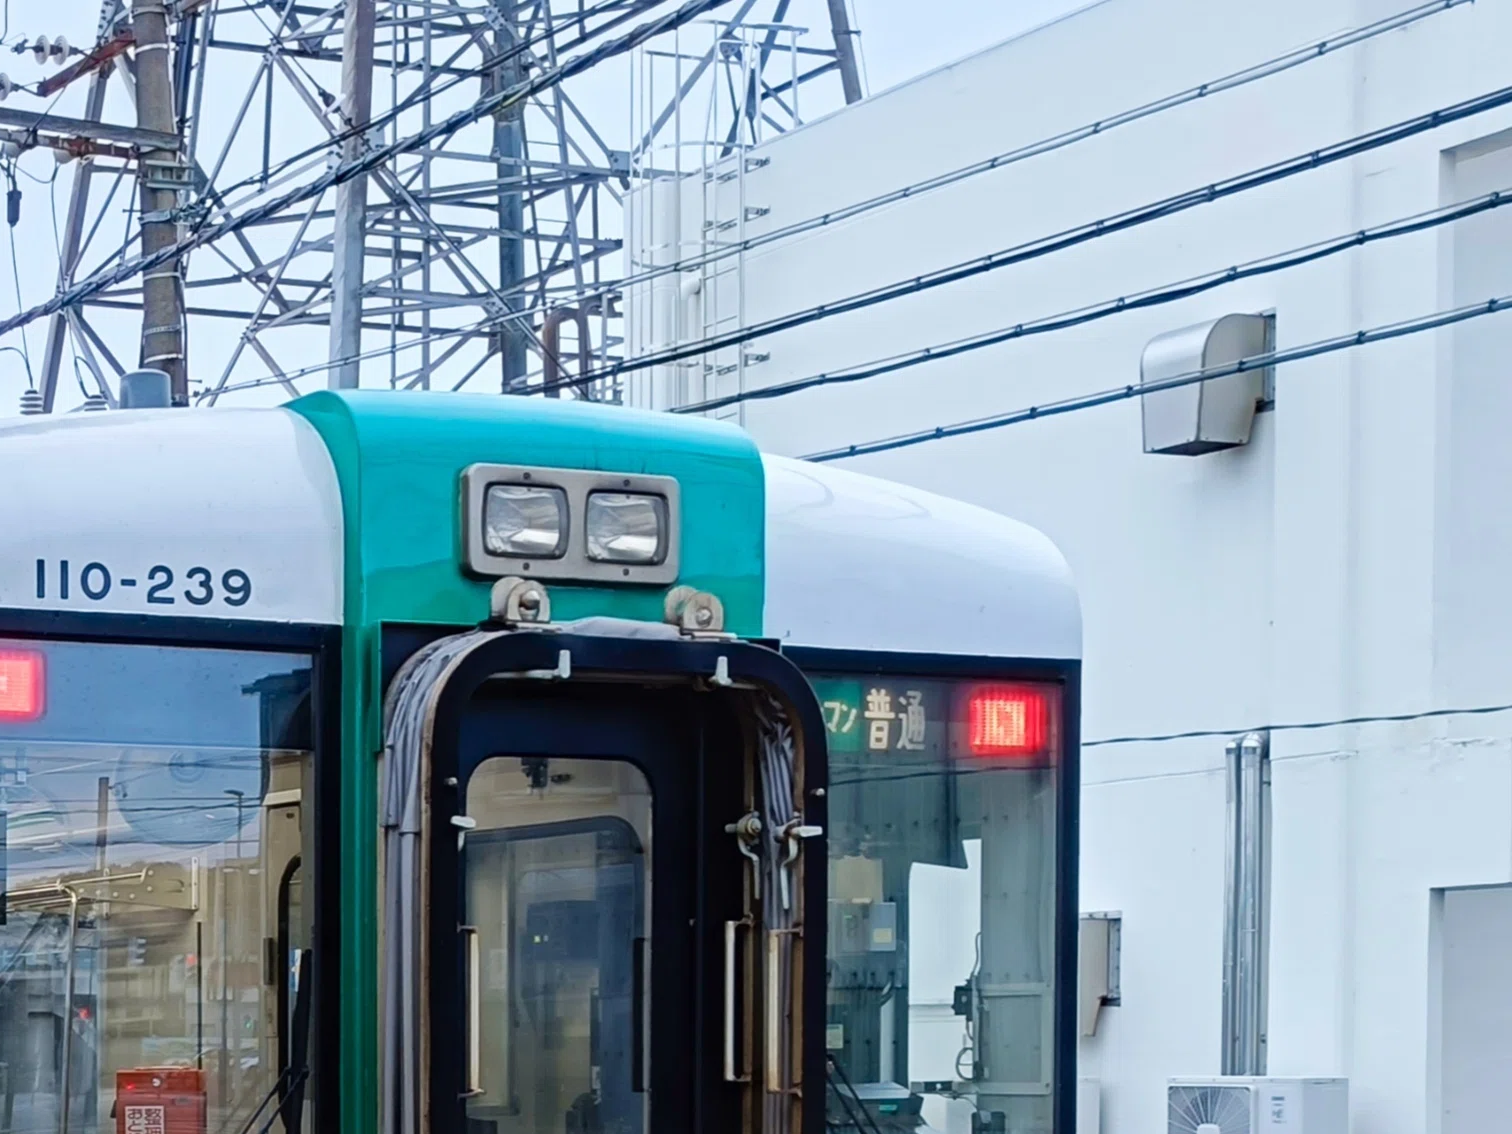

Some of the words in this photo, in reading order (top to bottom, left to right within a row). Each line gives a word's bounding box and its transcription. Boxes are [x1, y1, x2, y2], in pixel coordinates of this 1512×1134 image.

[35, 557, 253, 607] 110-239
[820, 700, 858, 734] マン
[863, 687, 927, 751] 普通
